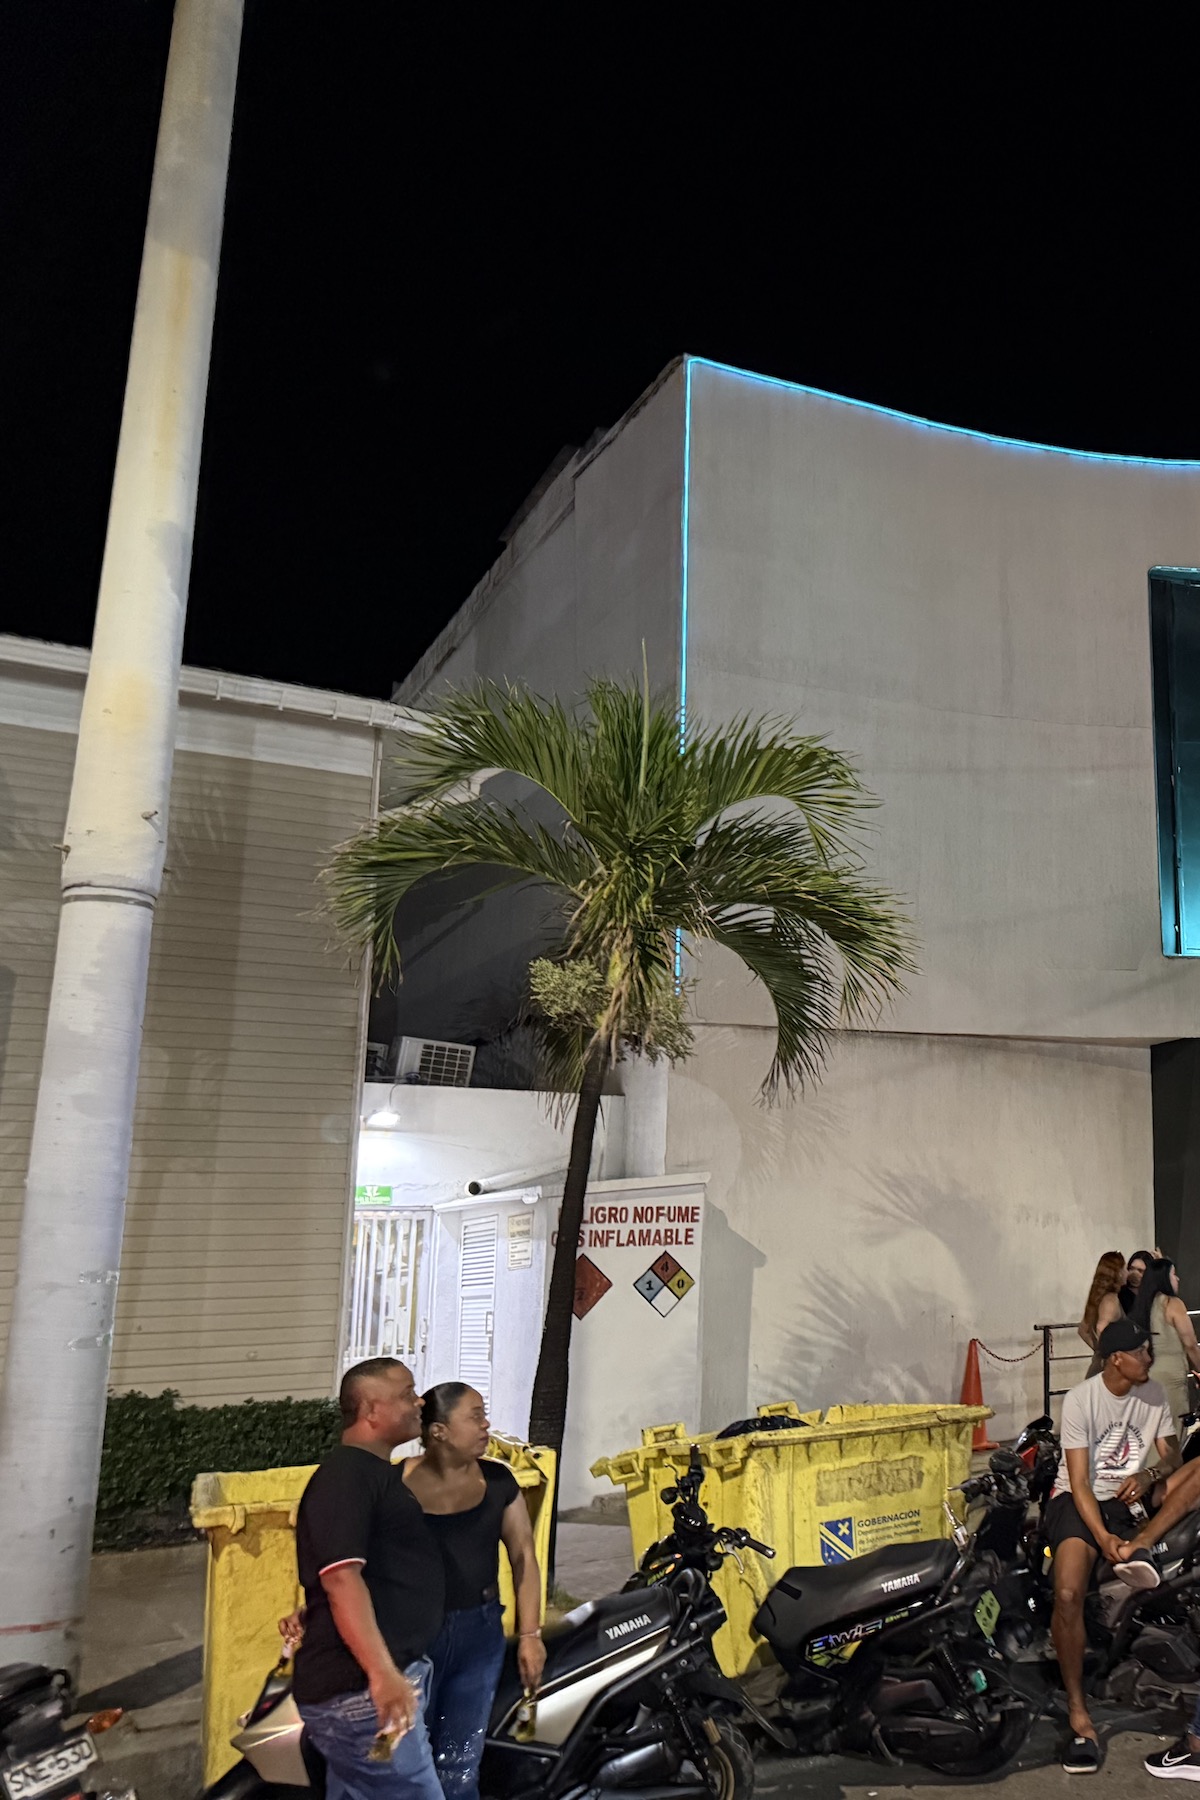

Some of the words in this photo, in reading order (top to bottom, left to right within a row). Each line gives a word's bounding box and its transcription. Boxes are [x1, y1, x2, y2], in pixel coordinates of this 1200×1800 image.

[588, 1228, 694, 1248] INFLAMABLE
[881, 1573, 920, 1593] YAMAHA
[605, 1613, 652, 1640] YAMAHA
